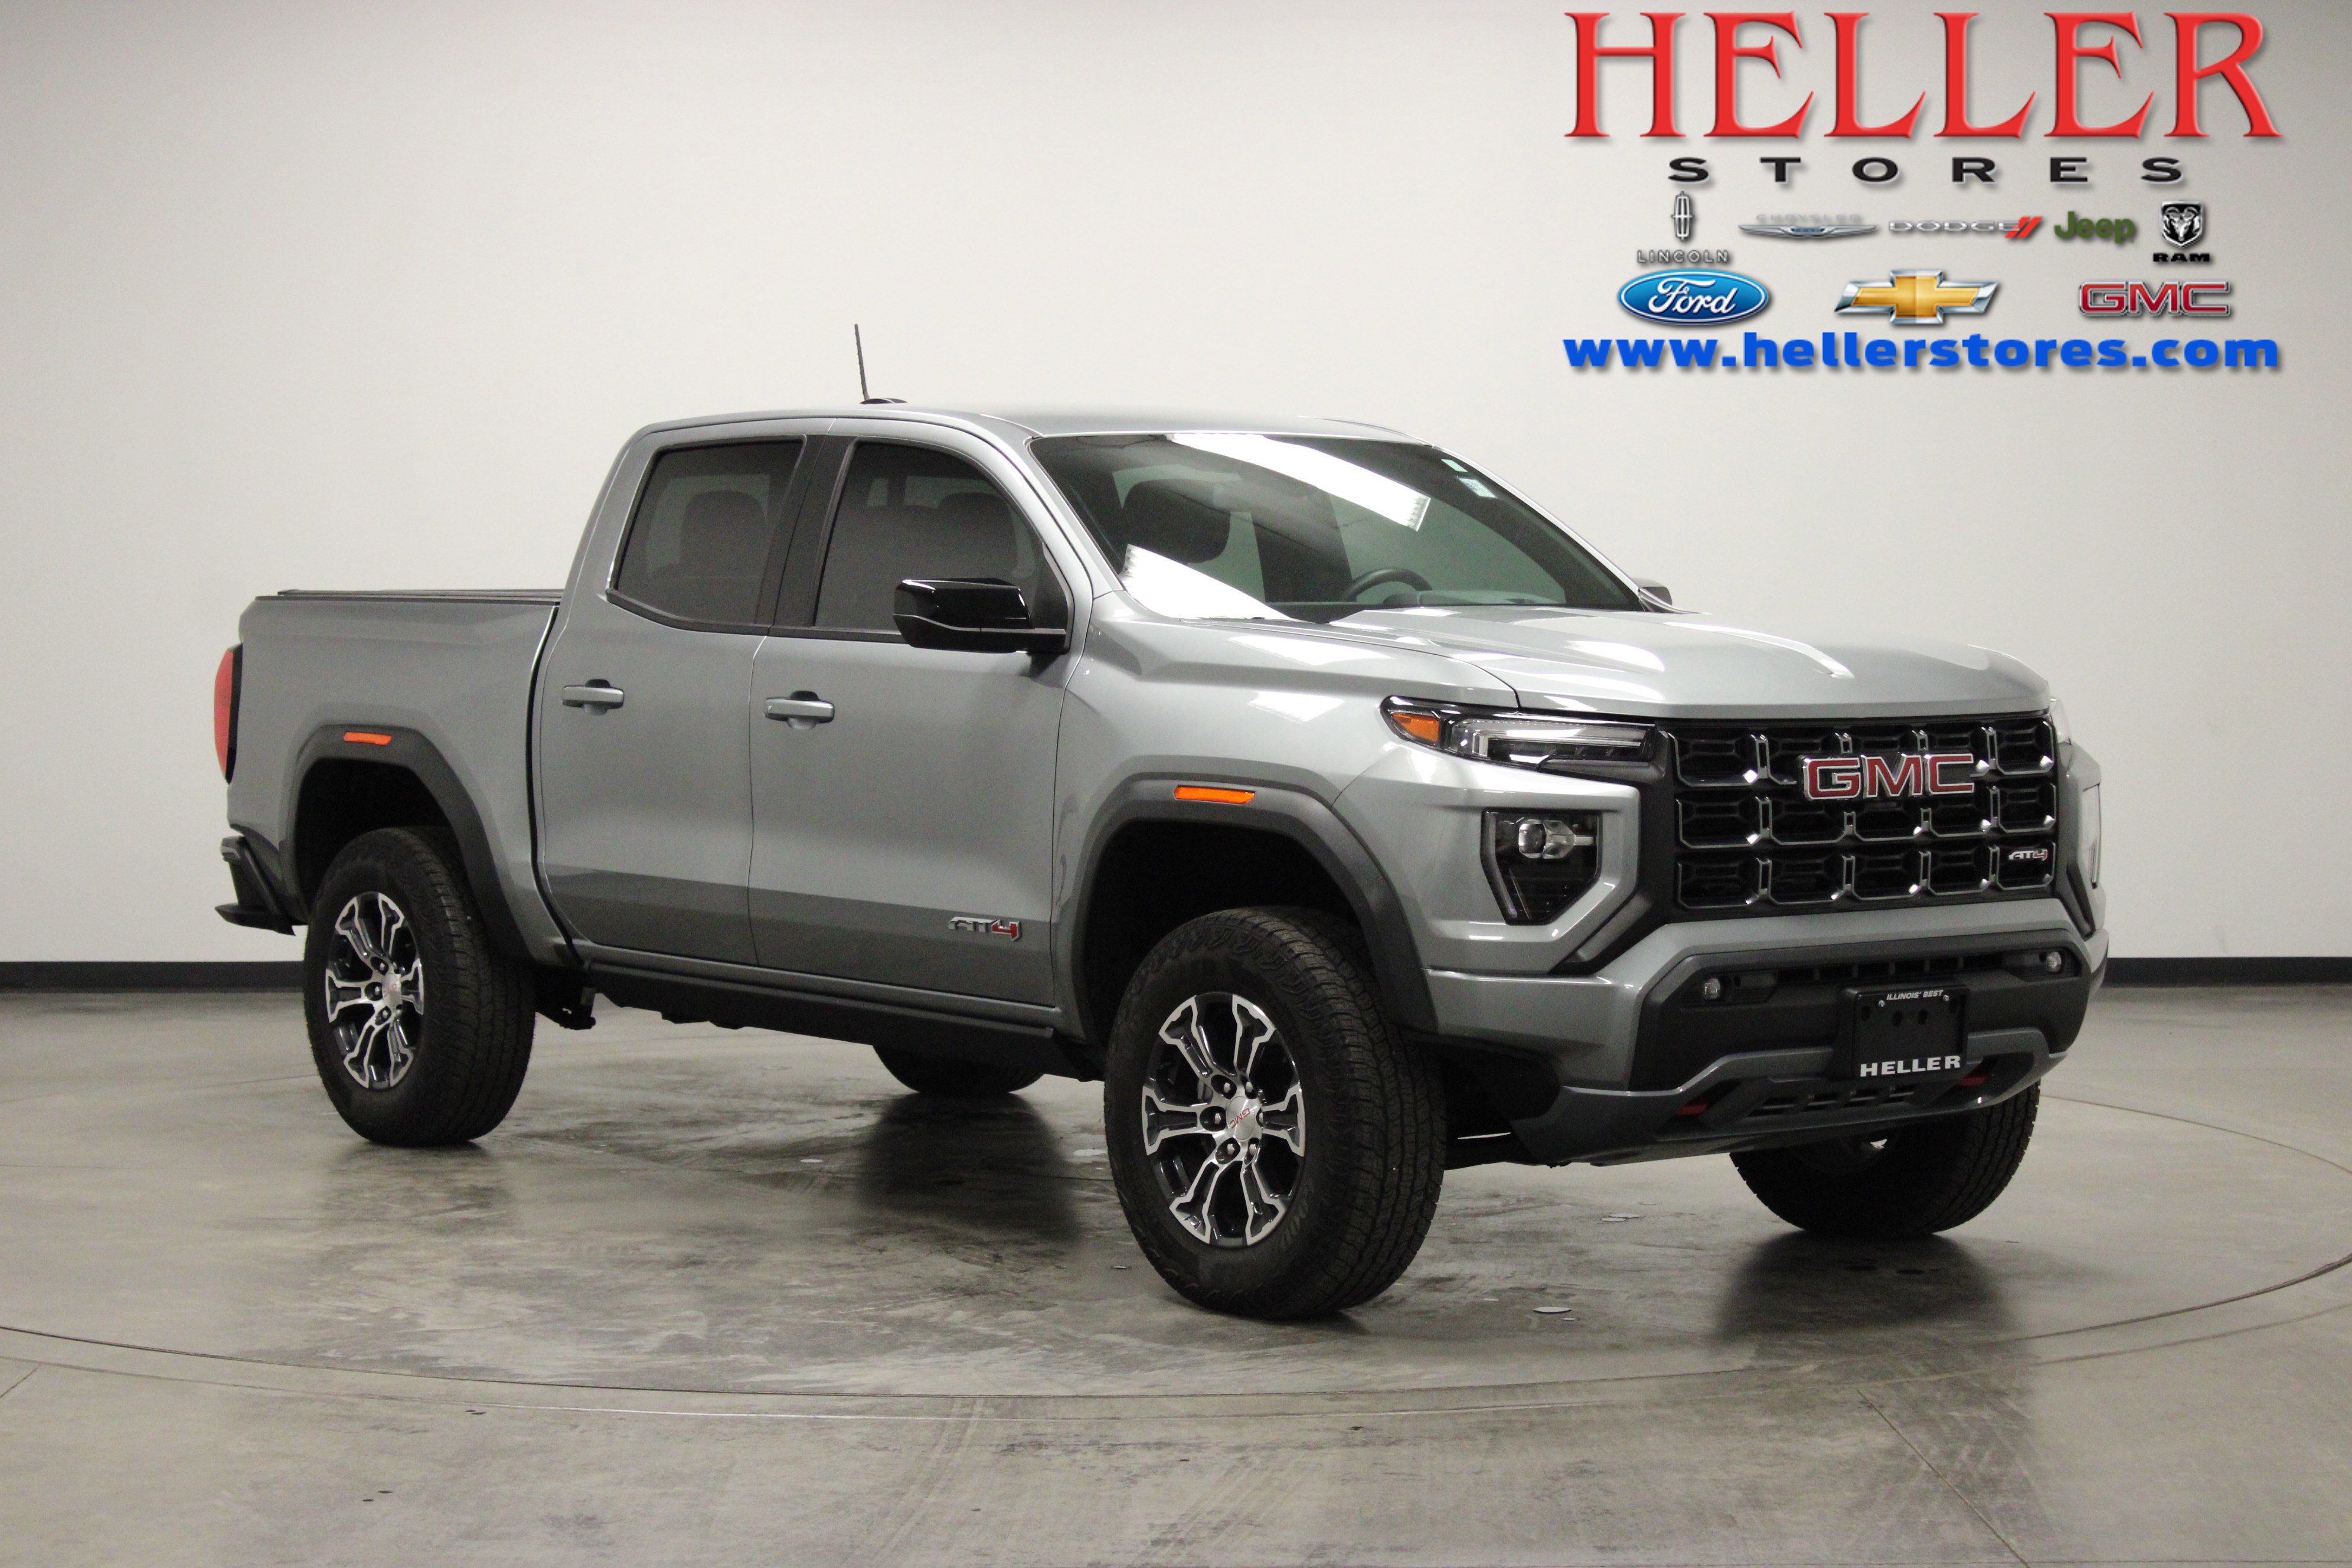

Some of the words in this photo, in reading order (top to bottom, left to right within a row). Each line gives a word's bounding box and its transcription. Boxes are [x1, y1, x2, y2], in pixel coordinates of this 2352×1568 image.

[1803, 753, 1974, 800] GMC
[2008, 849, 2048, 861] AT4
[948, 917, 1020, 941] AT4
[1886, 992, 1921, 1001] ILLINOIS'
[1923, 989, 1944, 998] BEST
[1860, 1055, 1961, 1077] HELLER
[1229, 1108, 1250, 1129] GMC
